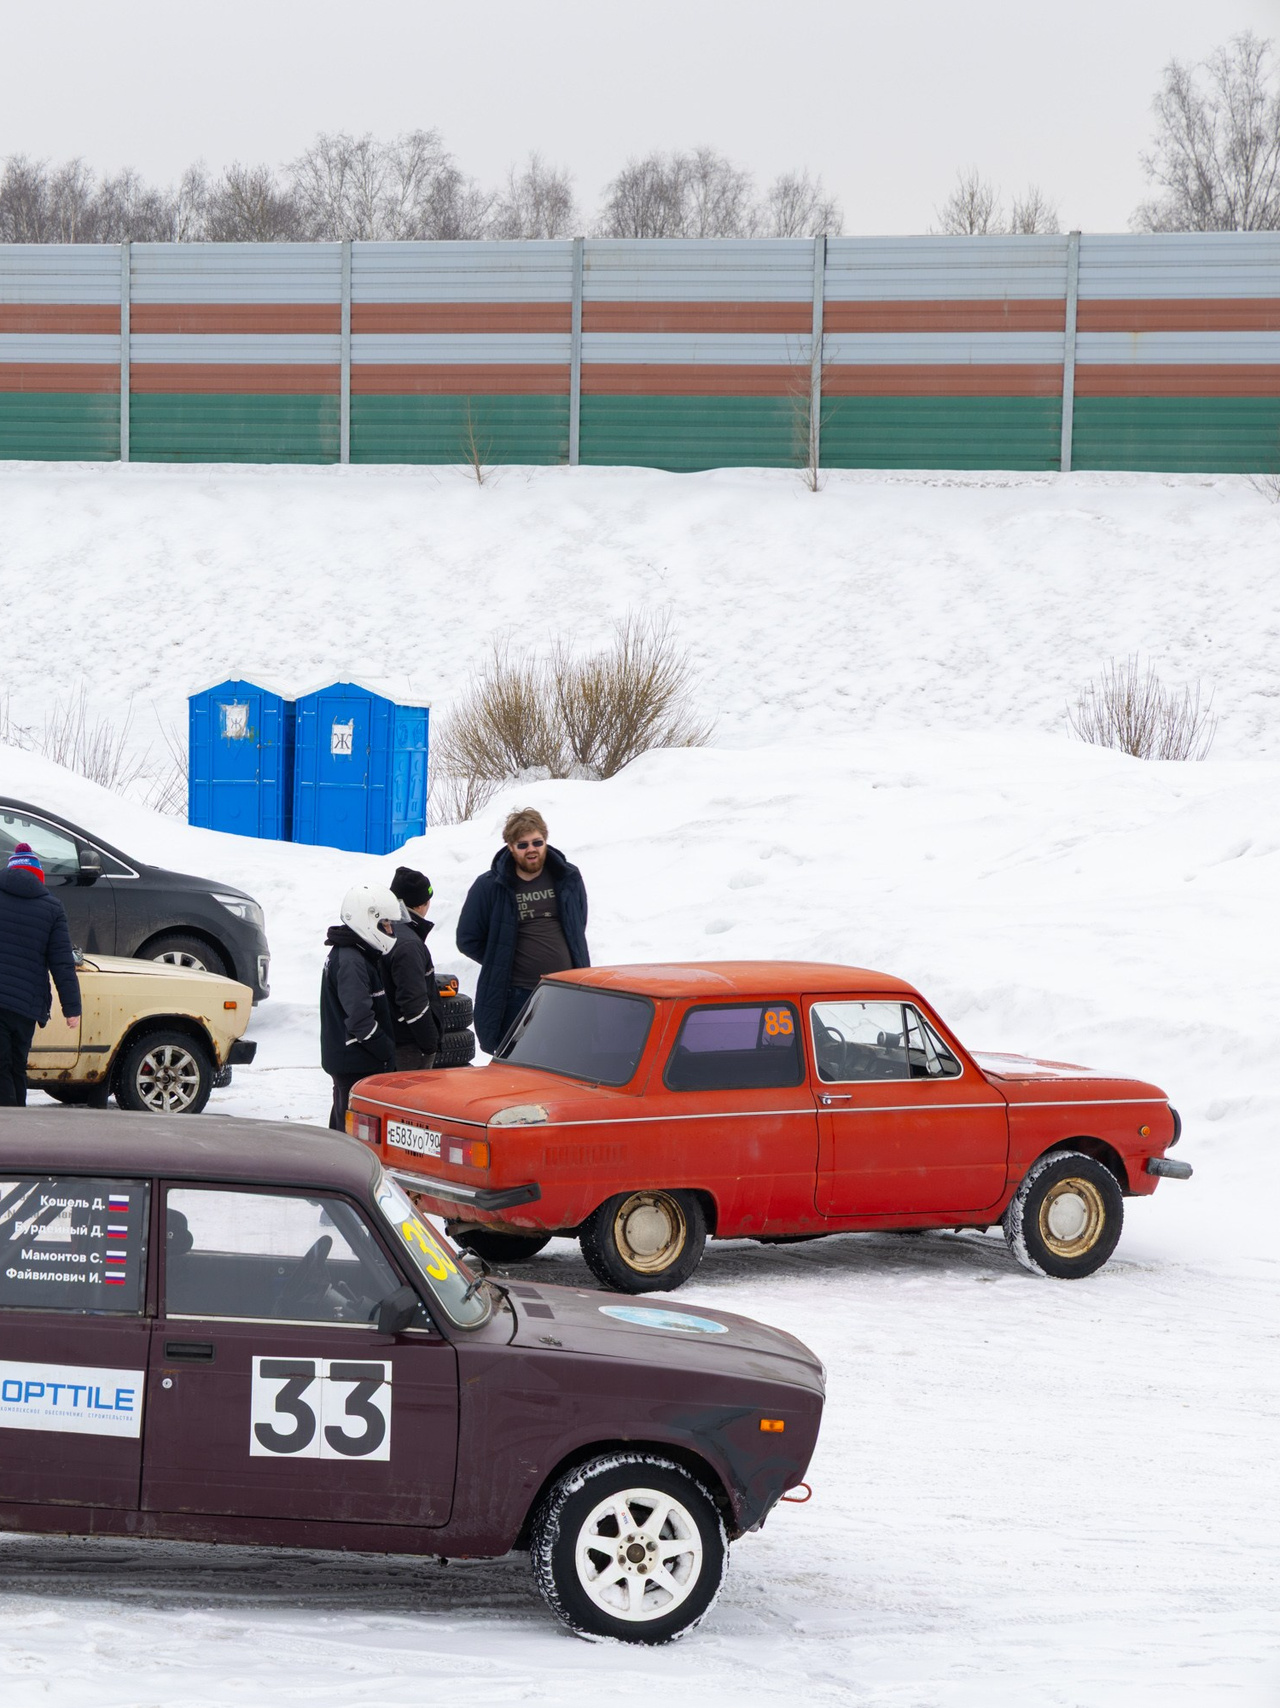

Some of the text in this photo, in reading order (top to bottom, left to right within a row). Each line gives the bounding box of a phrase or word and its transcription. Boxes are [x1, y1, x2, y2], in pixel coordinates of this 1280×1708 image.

[230, 718, 242, 729] Ж
[334, 733, 352, 749] Ж
[515, 889, 555, 903] EMOVE
[764, 1010, 793, 1035] 85
[390, 1126, 440, 1150] Е583УО 790
[40, 1195, 89, 1208] Кошель
[91, 1198, 106, 1210] Д.
[90, 1225, 104, 1238] Д.
[21, 1249, 103, 1264] Мамонтов С.
[401, 1218, 457, 1281] 33
[6, 1268, 102, 1284] Файвилович И.
[1, 1379, 135, 1411] OPTTILE
[0, 1406, 133, 1421] КОМПЛЕКСНОЕ ОБЕСПЕЧЕНИЕ СТРОИТЕЛЬСТВА
[254, 1359, 386, 1456] 33
